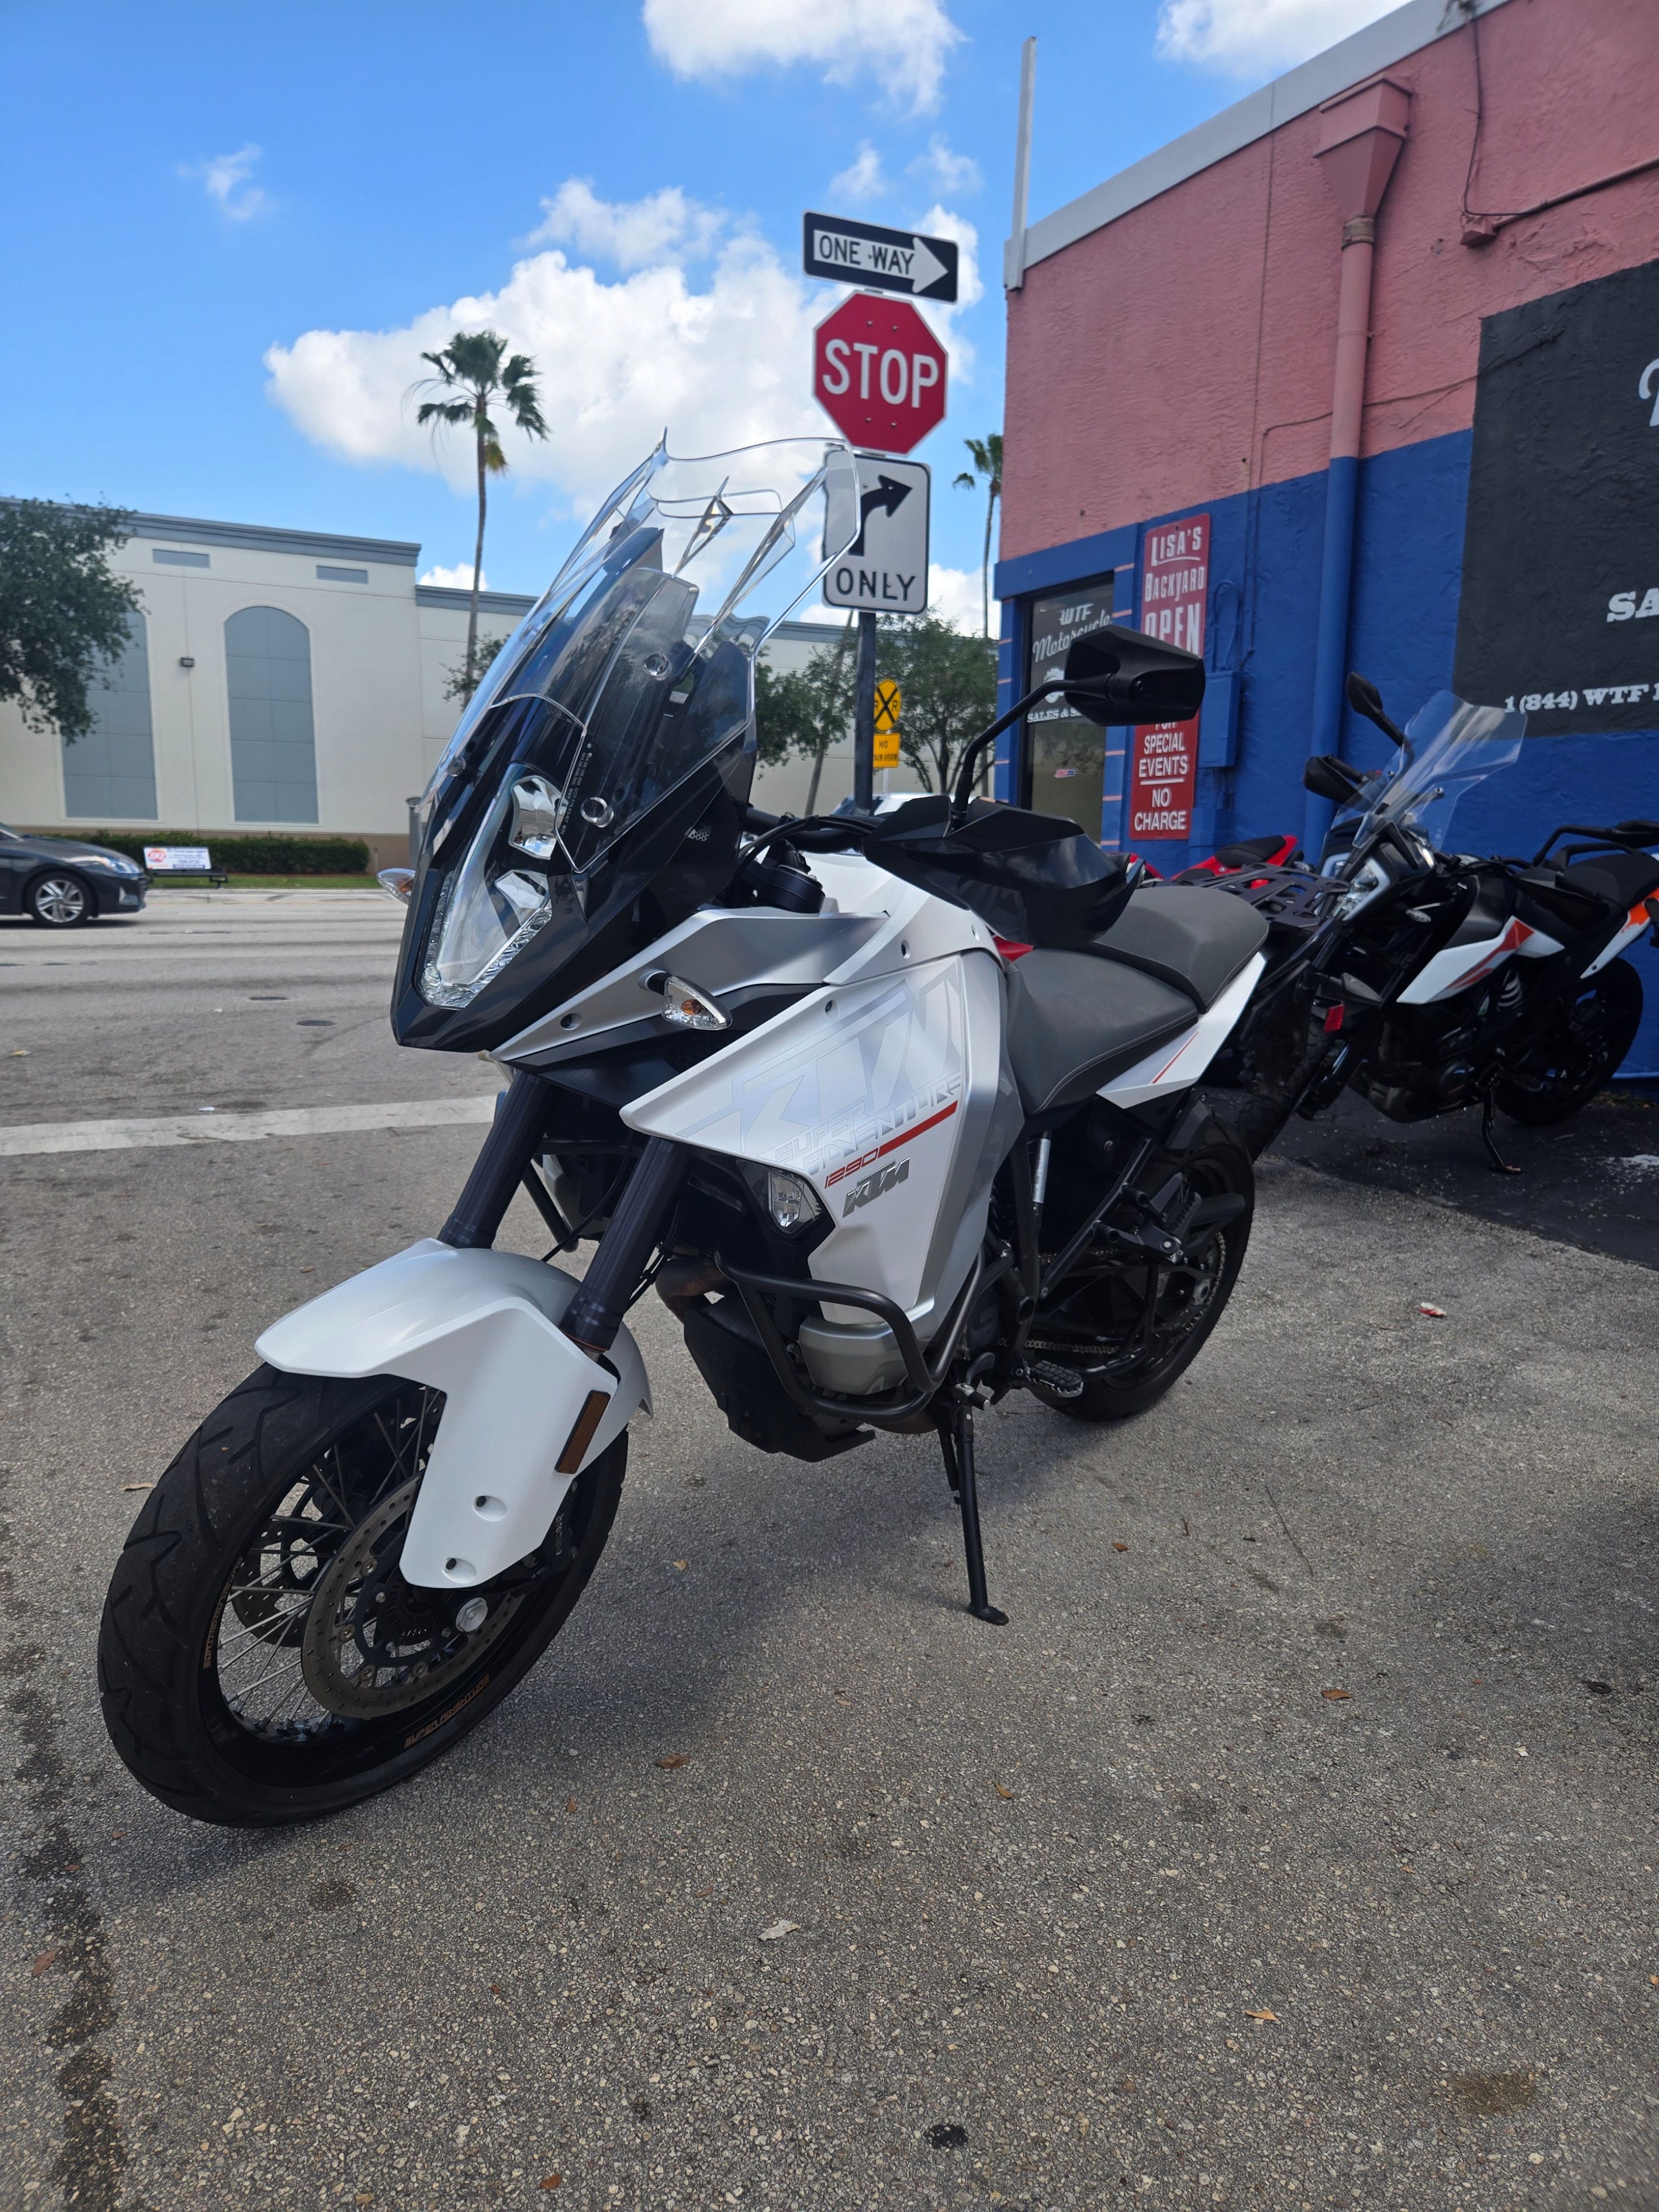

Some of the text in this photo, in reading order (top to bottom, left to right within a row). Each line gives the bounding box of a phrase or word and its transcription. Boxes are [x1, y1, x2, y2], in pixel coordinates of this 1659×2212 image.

[819, 234, 914, 275] ONE WAY
[822, 338, 939, 409] STOP
[1151, 526, 1202, 567] LISA'S
[836, 567, 916, 602] ONLY
[1059, 603, 1094, 625] WTF
[1504, 696, 1516, 713] 1
[1519, 690, 1578, 714] (844)
[1583, 684, 1649, 706] WTF
[1027, 709, 1059, 723] SALES
[1144, 732, 1186, 755] SPECIAL
[1139, 755, 1189, 778] EVENTS
[1152, 787, 1171, 807] NO
[1134, 811, 1187, 831] CHARGE
[824, 1147, 879, 1189] 1290
[842, 1156, 910, 1218] KTM
[404, 1672, 491, 1749] SUPER ADVENTURE
